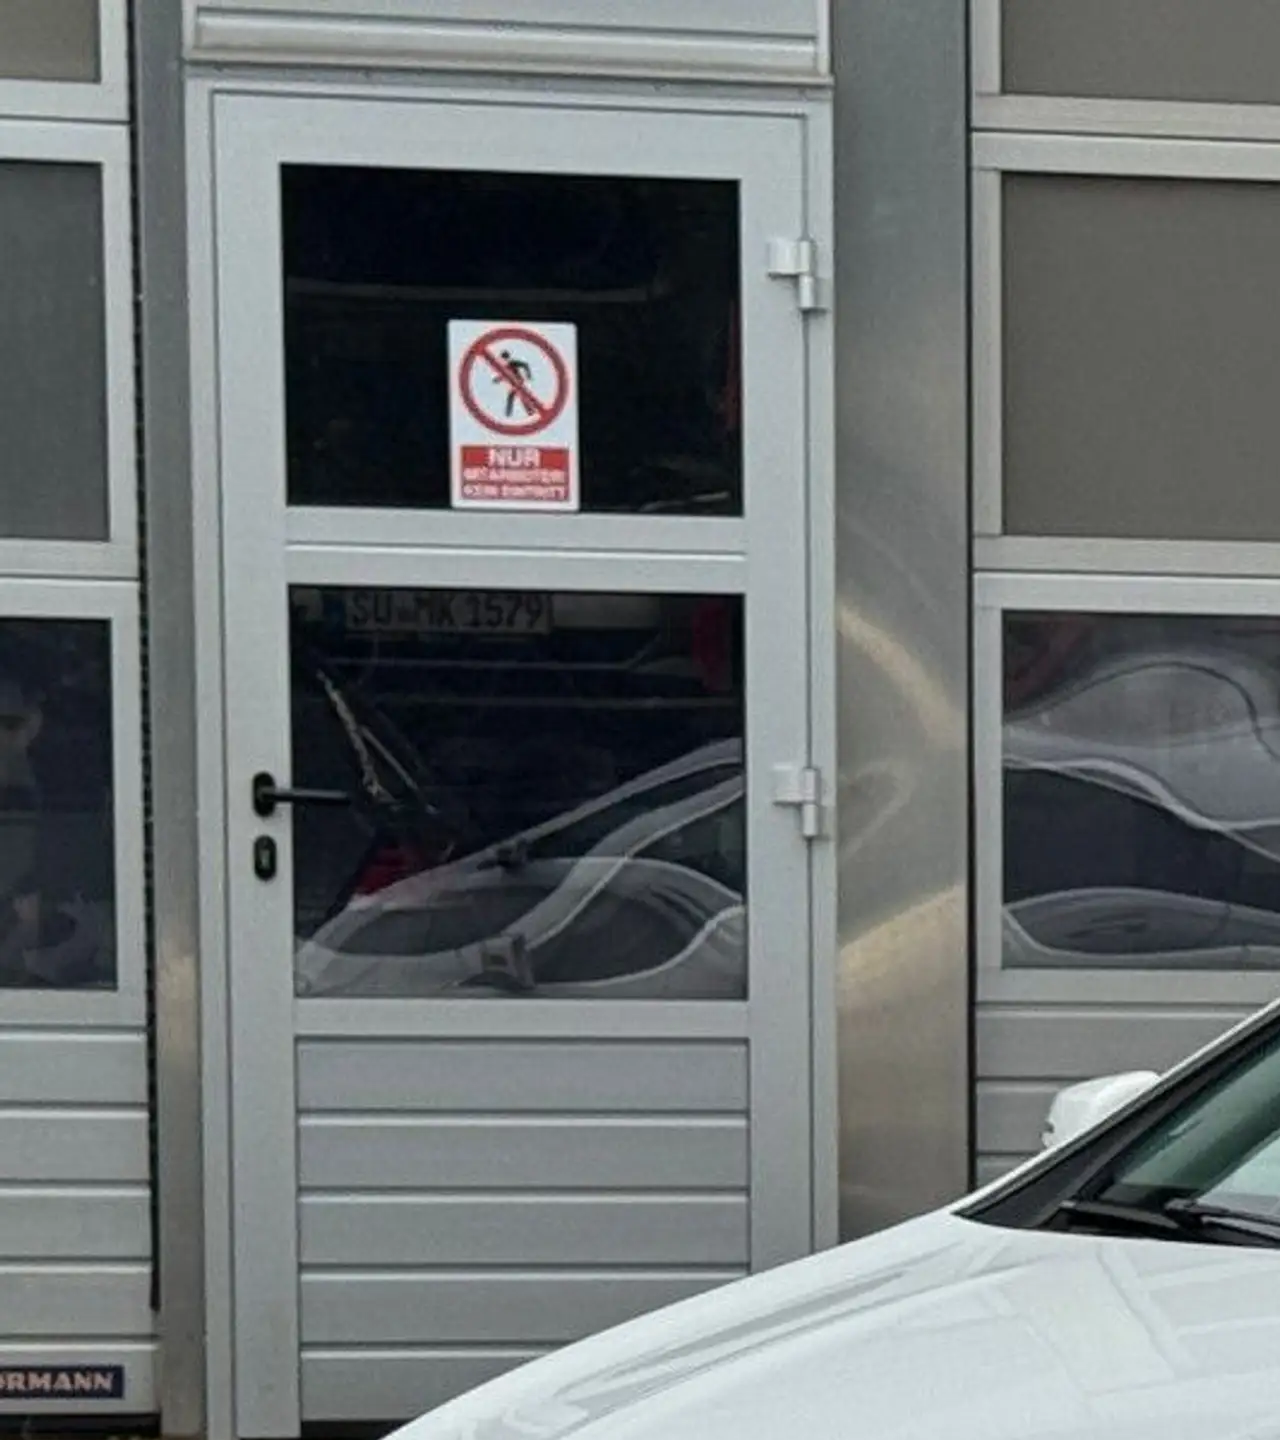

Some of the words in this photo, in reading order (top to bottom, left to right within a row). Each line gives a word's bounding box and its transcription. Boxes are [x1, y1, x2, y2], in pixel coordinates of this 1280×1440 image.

[489, 448, 541, 468] NUR
[466, 594, 543, 630] 1579
[0, 1371, 114, 1392] RMANN
